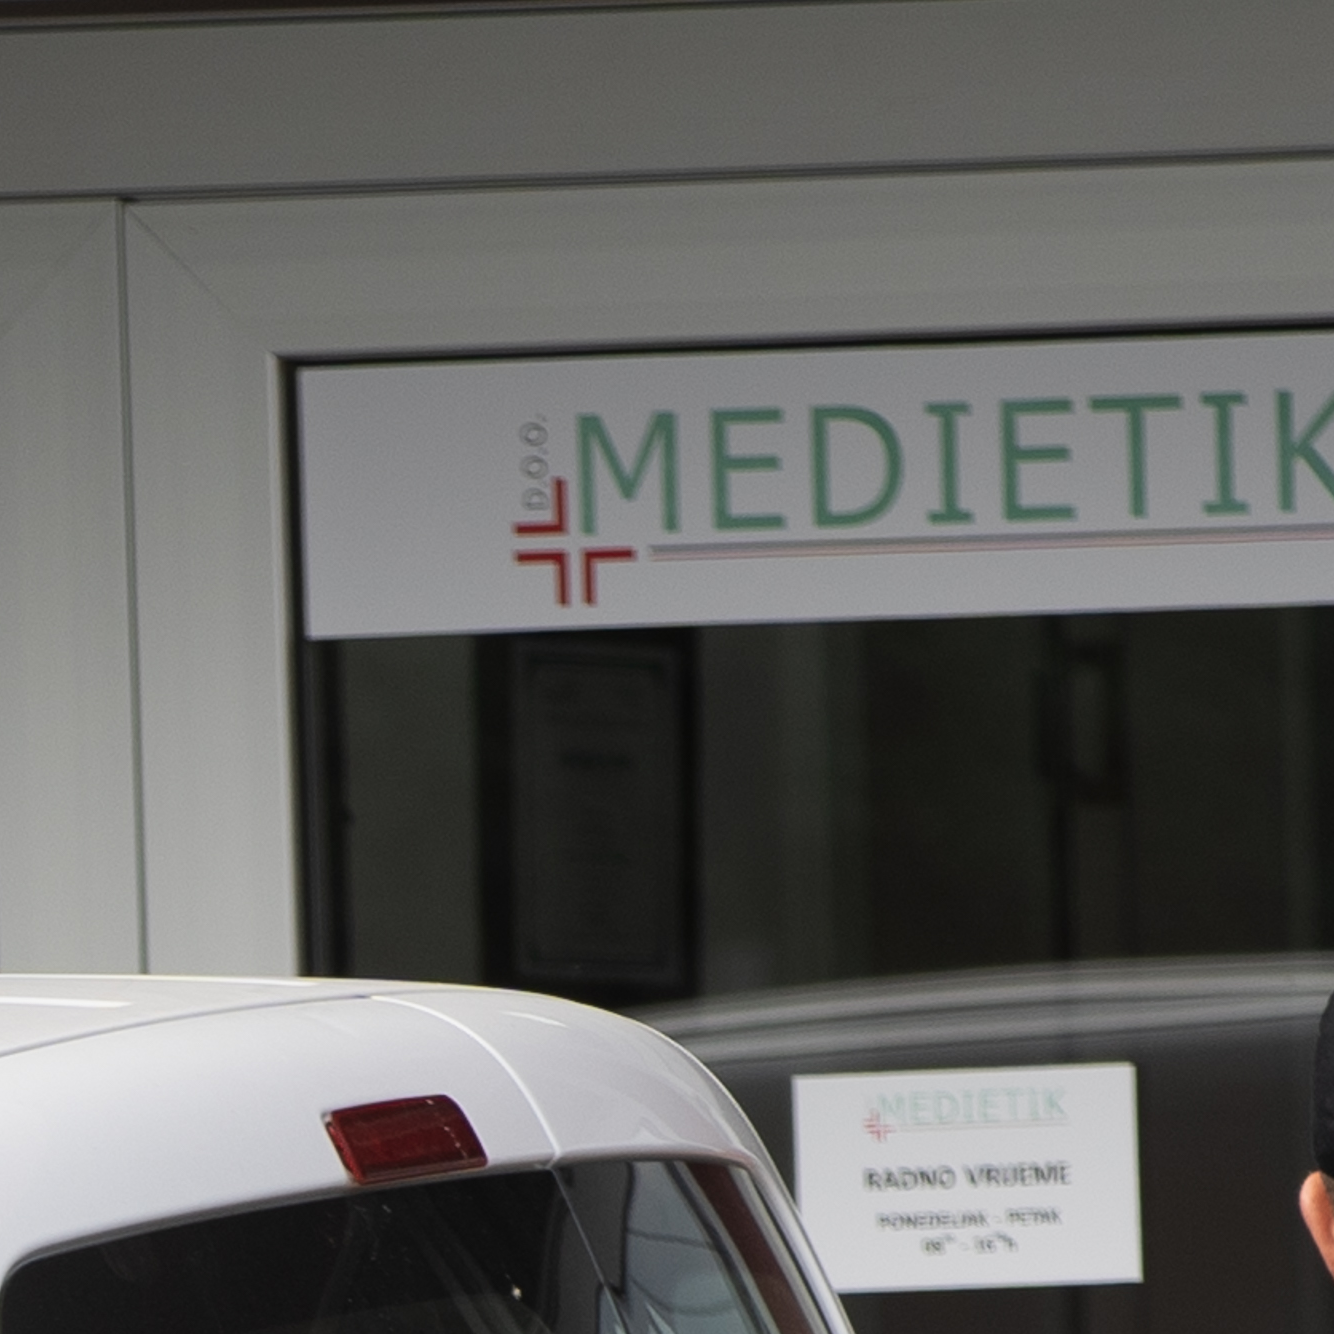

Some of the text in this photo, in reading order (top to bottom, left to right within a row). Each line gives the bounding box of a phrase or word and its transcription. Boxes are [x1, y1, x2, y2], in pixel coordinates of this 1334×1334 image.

[876, 1087, 1067, 1126] MEDIETIK
[863, 1159, 1072, 1192] RADNO VRIJEME
[1005, 1206, 1063, 1226] PETAK
